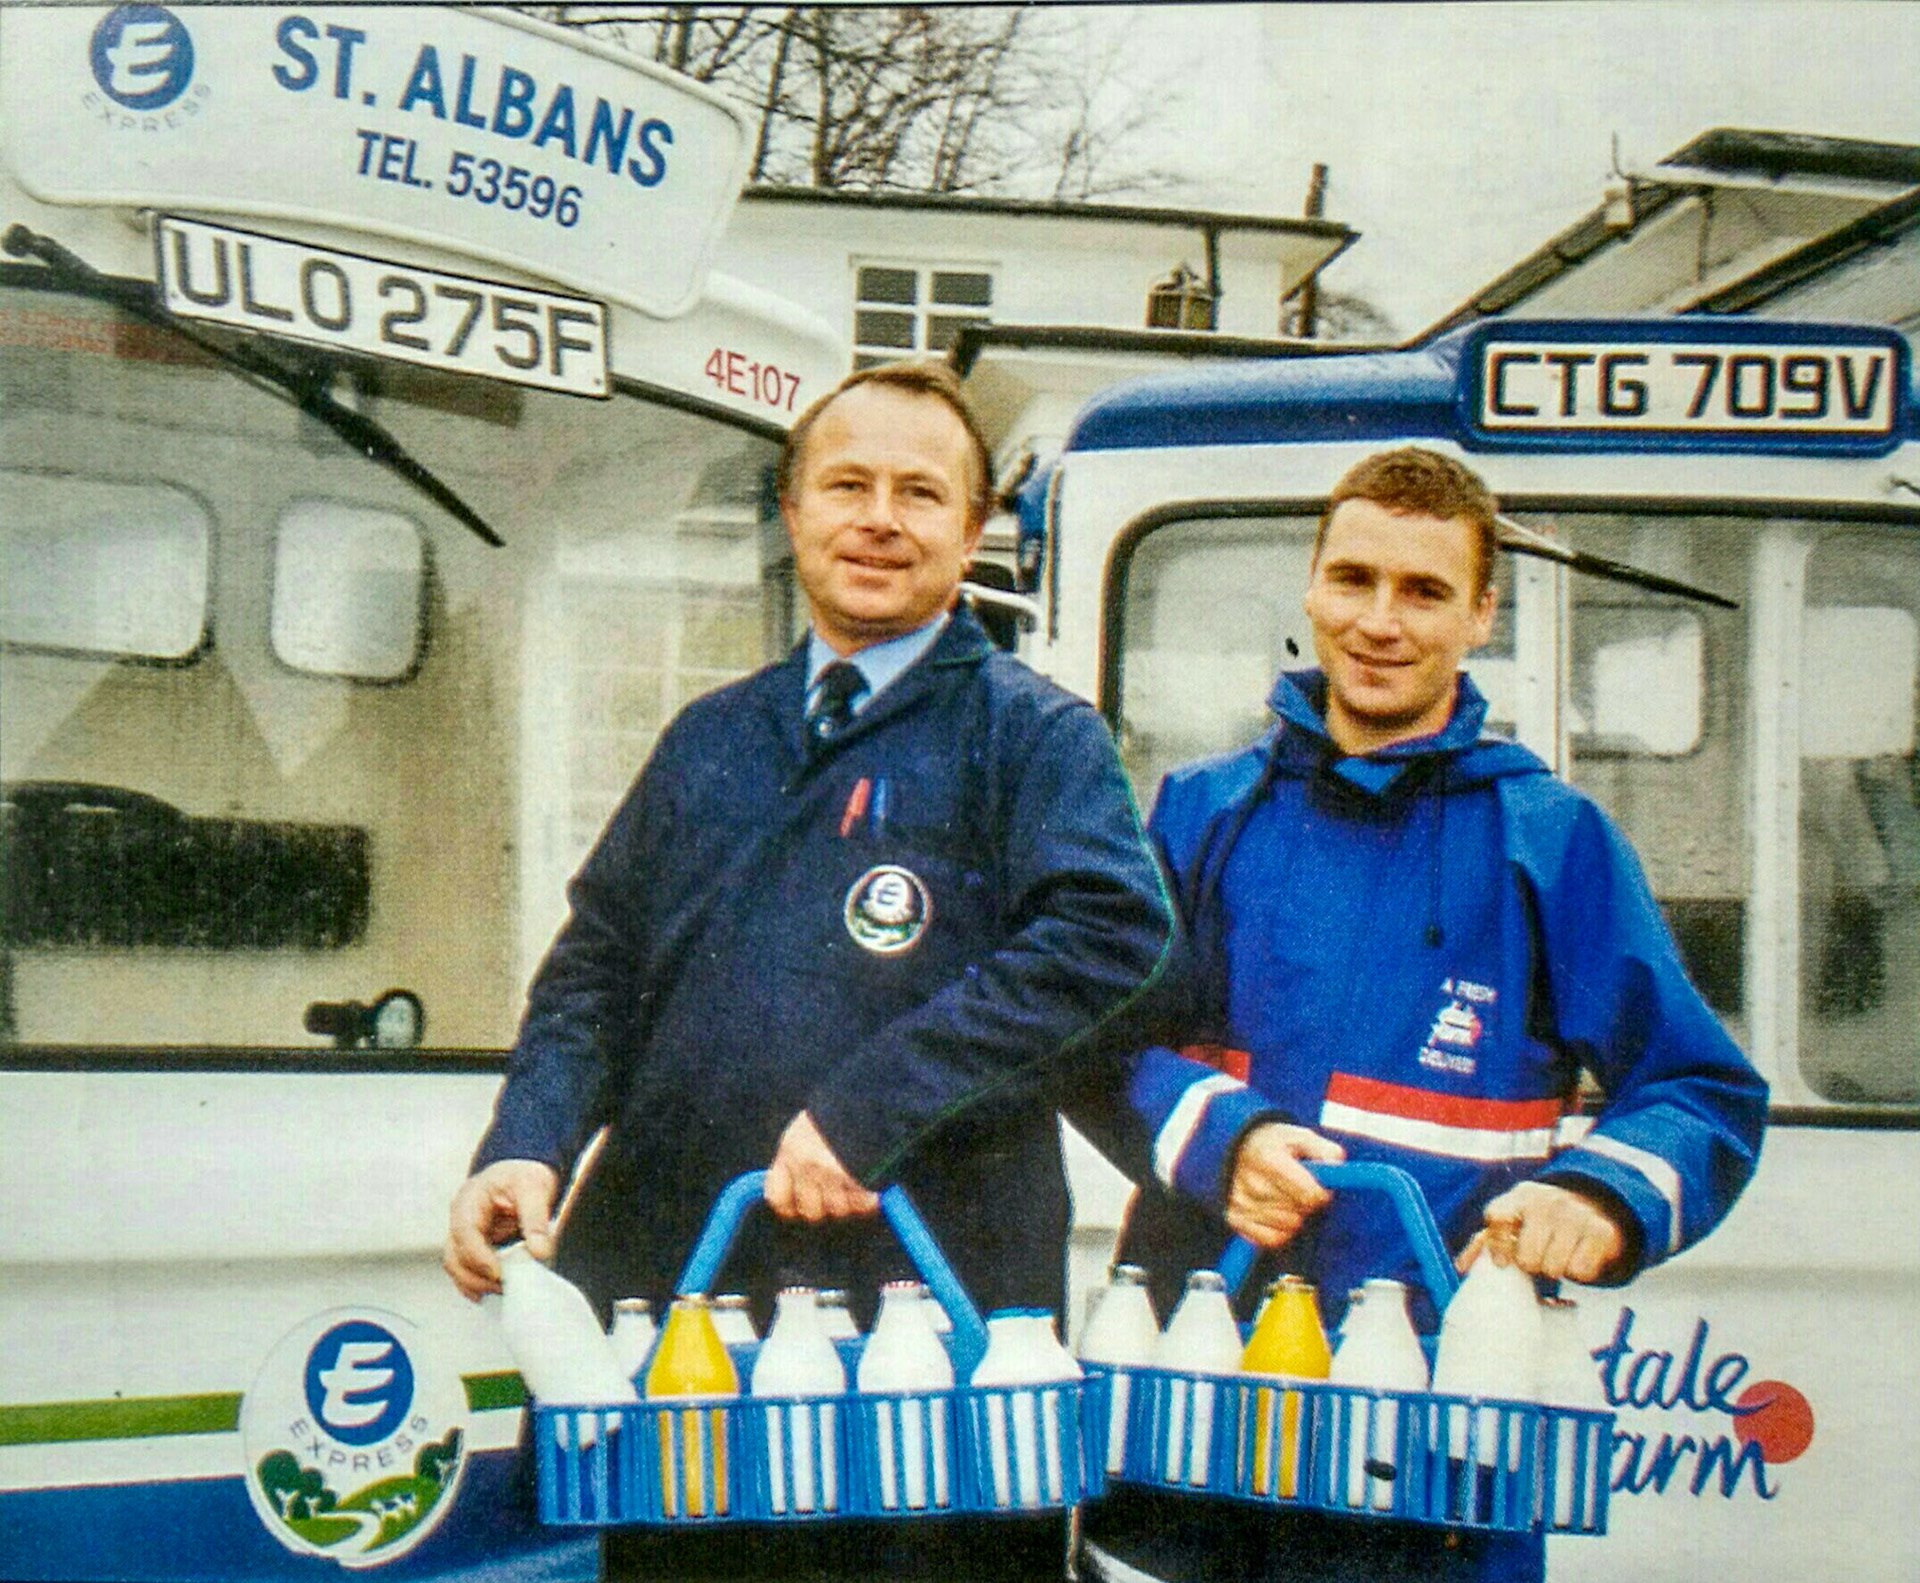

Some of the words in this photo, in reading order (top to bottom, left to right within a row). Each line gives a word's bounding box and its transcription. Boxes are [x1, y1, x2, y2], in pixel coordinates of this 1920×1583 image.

[272, 15, 376, 106] ST.
[399, 44, 674, 188] ALBANS
[356, 128, 432, 189] TEL.
[446, 150, 583, 228] 53596
[171, 229, 351, 332] ULO
[378, 274, 598, 376] 275F
[704, 348, 801, 412] 4E107
[1487, 352, 1650, 416] CTG
[1672, 353, 1886, 419] 709V
[1590, 1306, 1778, 1416] tale
[289, 1414, 428, 1472] EXPRESS
